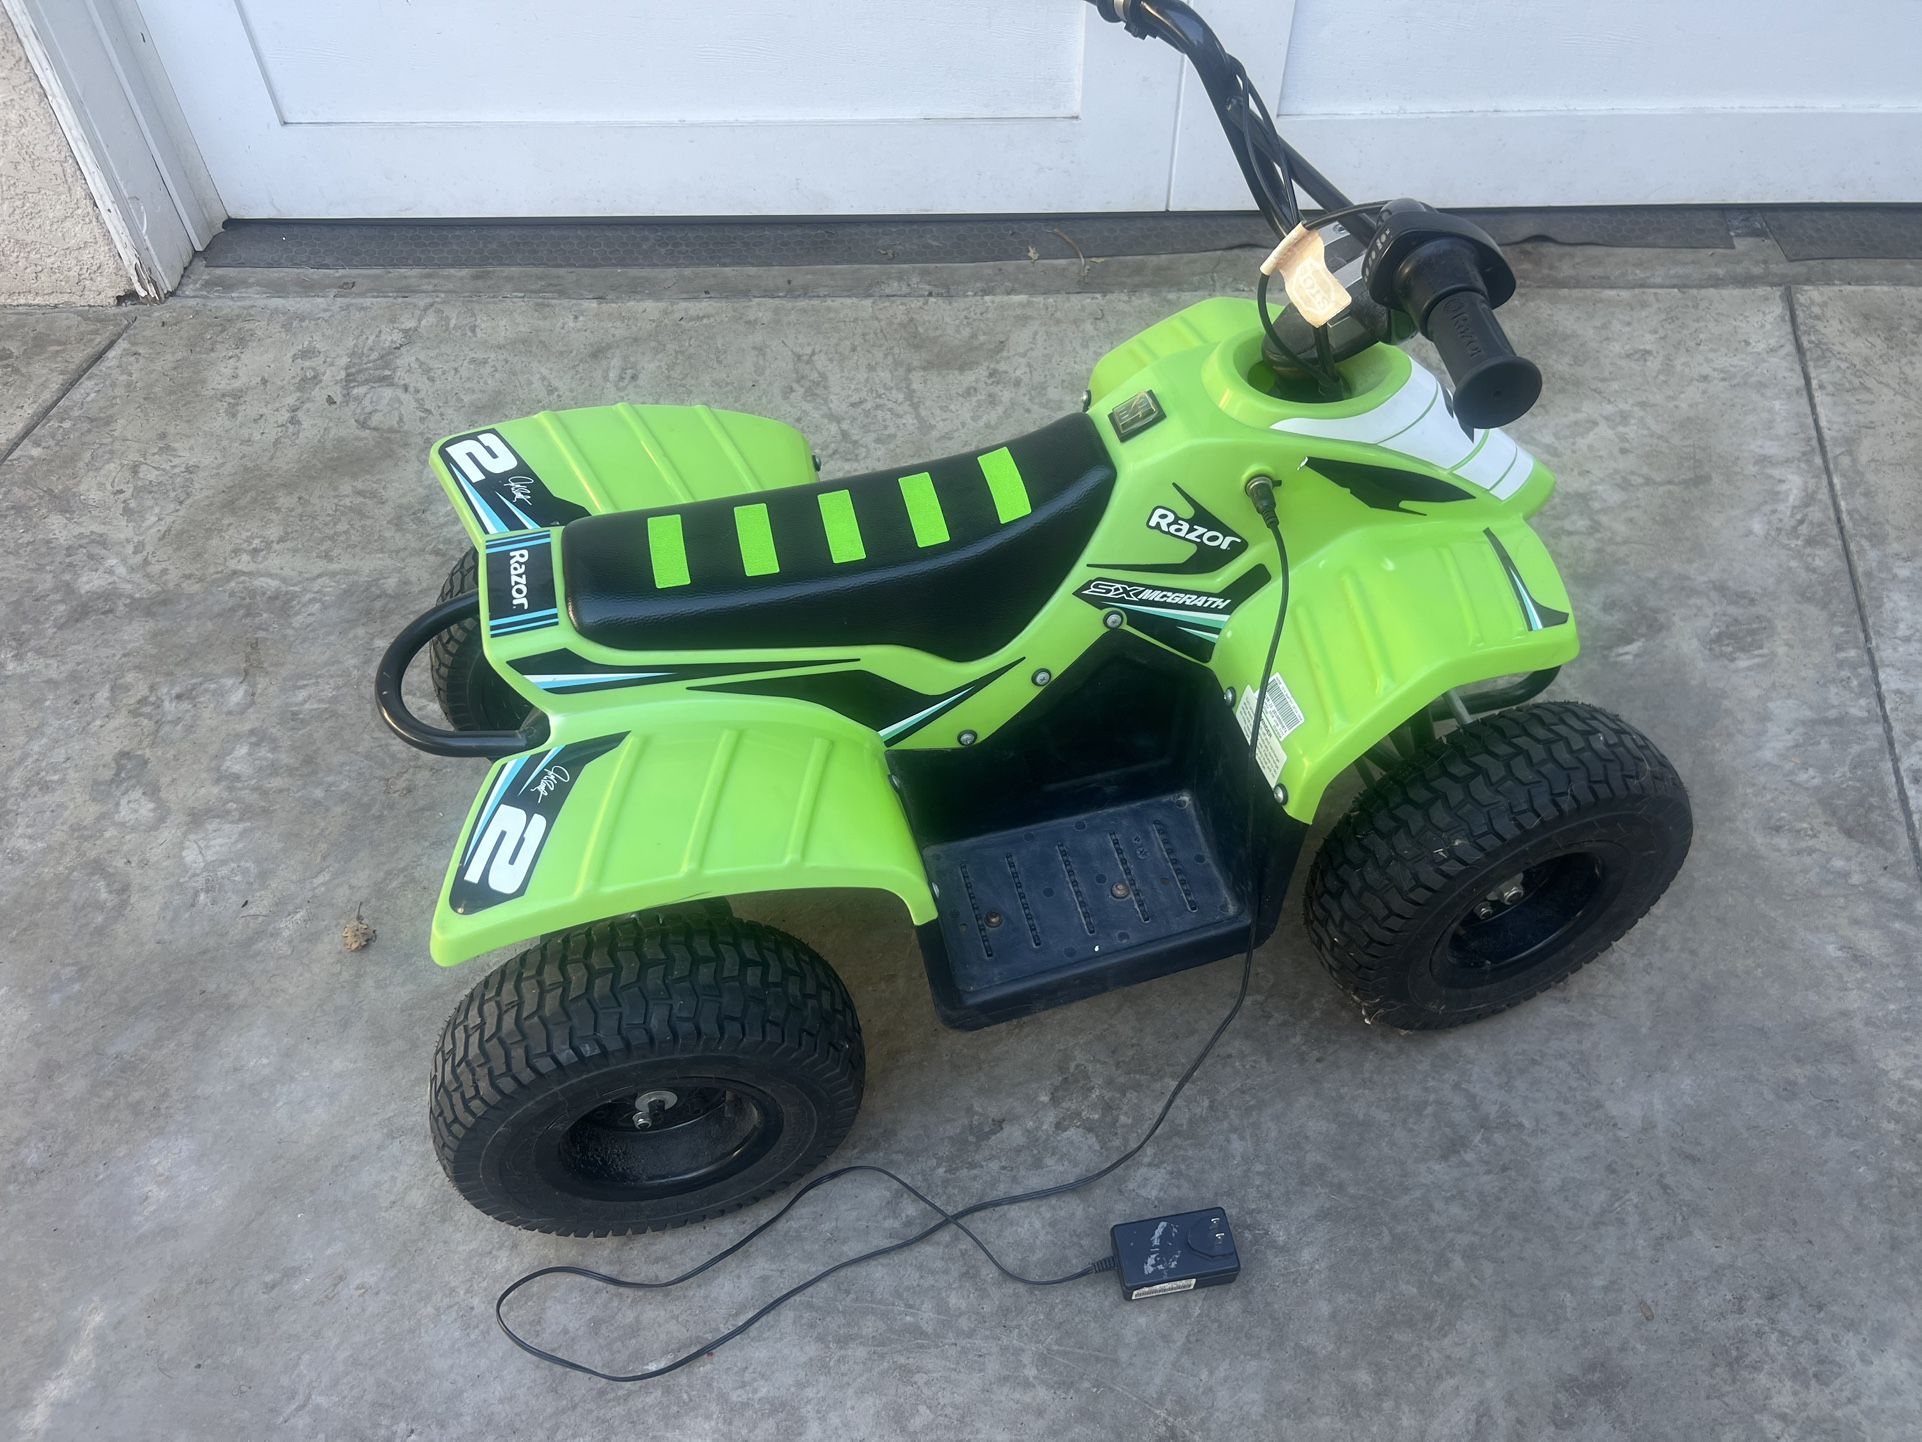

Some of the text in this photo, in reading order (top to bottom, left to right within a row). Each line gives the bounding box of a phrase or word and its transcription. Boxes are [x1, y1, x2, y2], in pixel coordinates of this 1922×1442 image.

[445, 432, 518, 484] 2
[1149, 507, 1241, 550] Razor
[509, 549, 529, 610] Razor
[463, 803, 547, 895] 2
